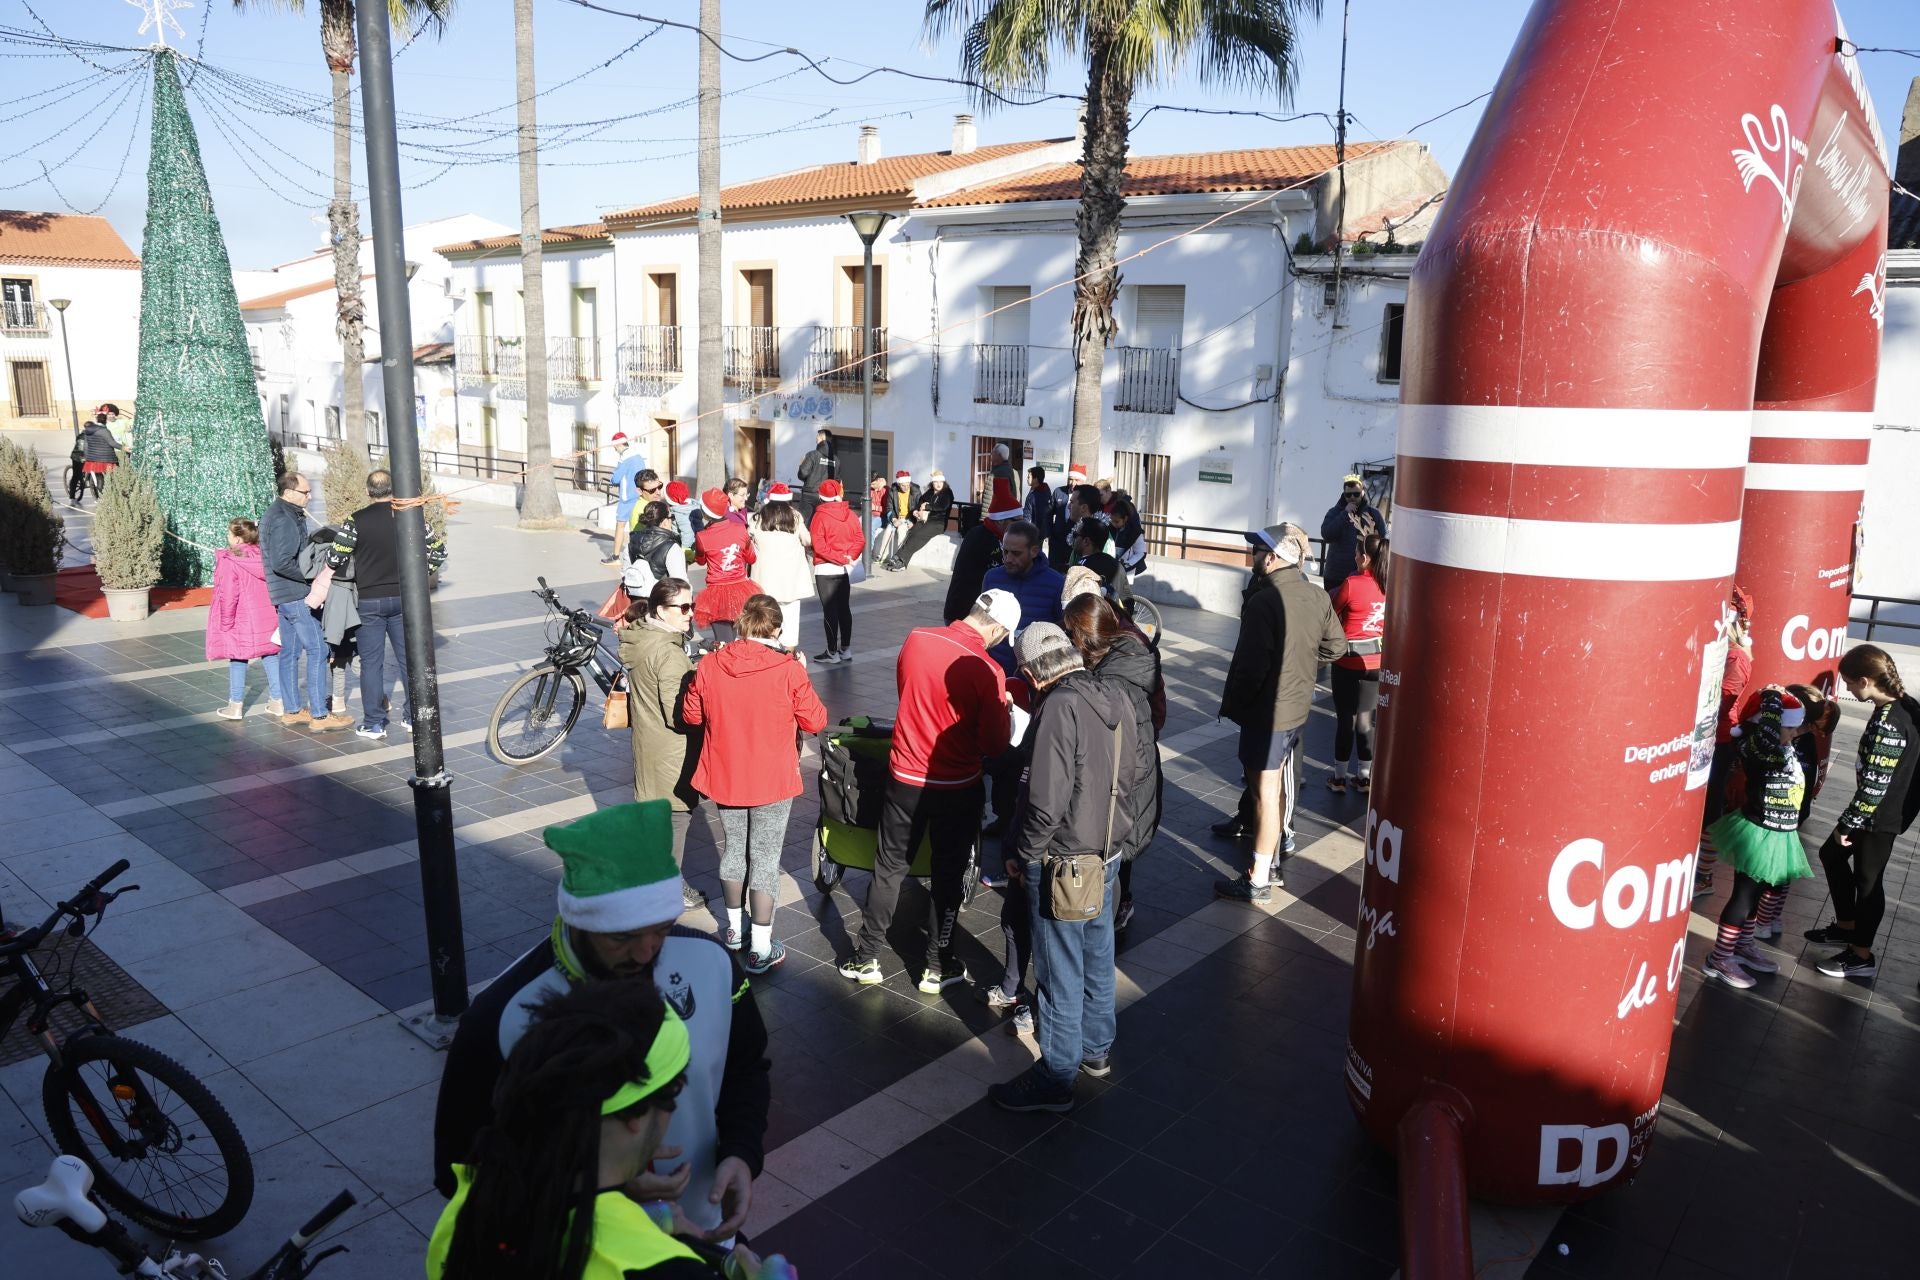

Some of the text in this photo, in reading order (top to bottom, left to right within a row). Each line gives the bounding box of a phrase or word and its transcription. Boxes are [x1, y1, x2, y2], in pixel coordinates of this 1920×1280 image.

[1386, 669, 1401, 686] Real
[1649, 760, 1688, 784] entre
[1617, 960, 1657, 1019] de
